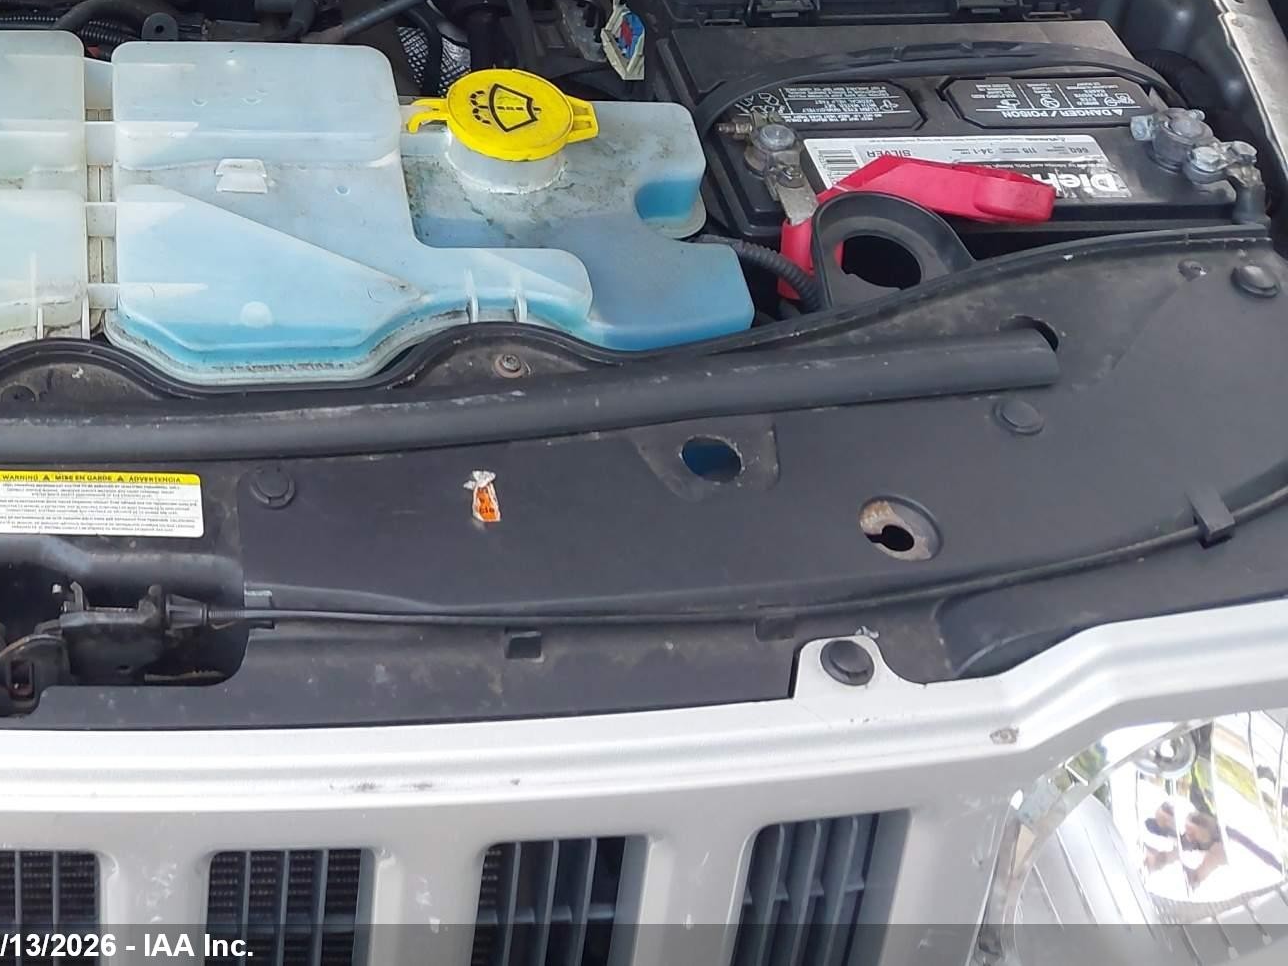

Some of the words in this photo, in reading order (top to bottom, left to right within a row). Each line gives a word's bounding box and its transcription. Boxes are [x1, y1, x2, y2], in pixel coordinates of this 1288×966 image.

[1001, 110, 1048, 118] POISON
[1060, 109, 1112, 117] DANGER
[866, 149, 912, 158] SILVER
